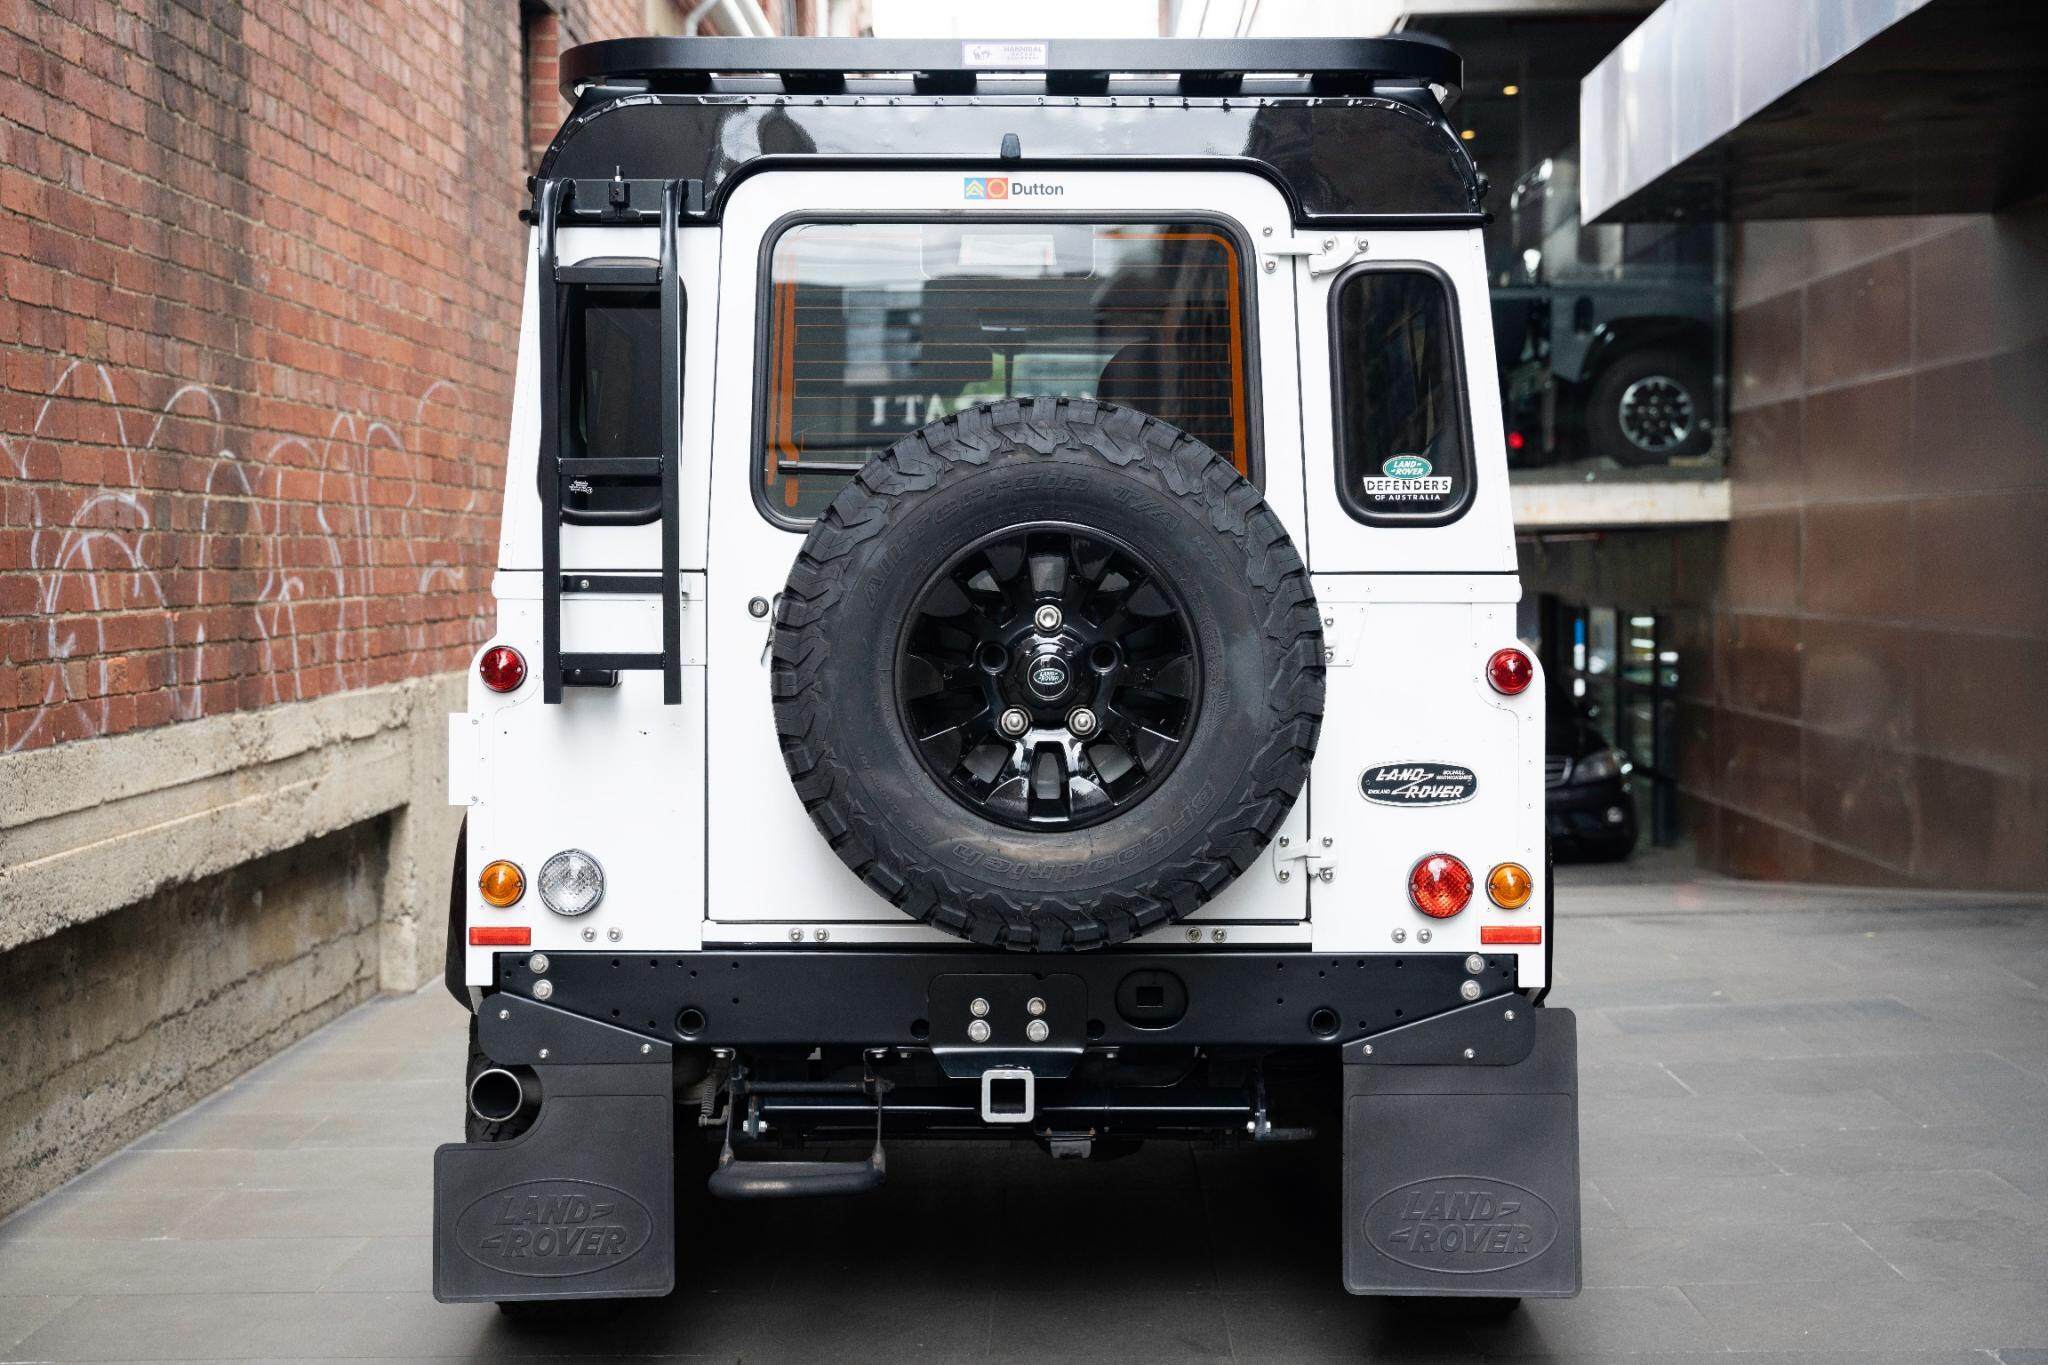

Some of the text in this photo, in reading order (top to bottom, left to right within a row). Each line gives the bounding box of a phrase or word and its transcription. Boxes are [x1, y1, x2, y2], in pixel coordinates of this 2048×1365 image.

[1011, 182, 1064, 196] Dutton
[1393, 460, 1417, 468] LAND
[1395, 467, 1424, 476] ROVER
[1366, 480, 1449, 491] DEFENDERS
[1375, 768, 1425, 781] LAND
[1405, 785, 1465, 799] ROVER
[494, 1195, 591, 1225] LAND
[1401, 1191, 1497, 1221] LAND
[501, 1226, 627, 1258] ROVER
[1409, 1223, 1535, 1254] ROVER
